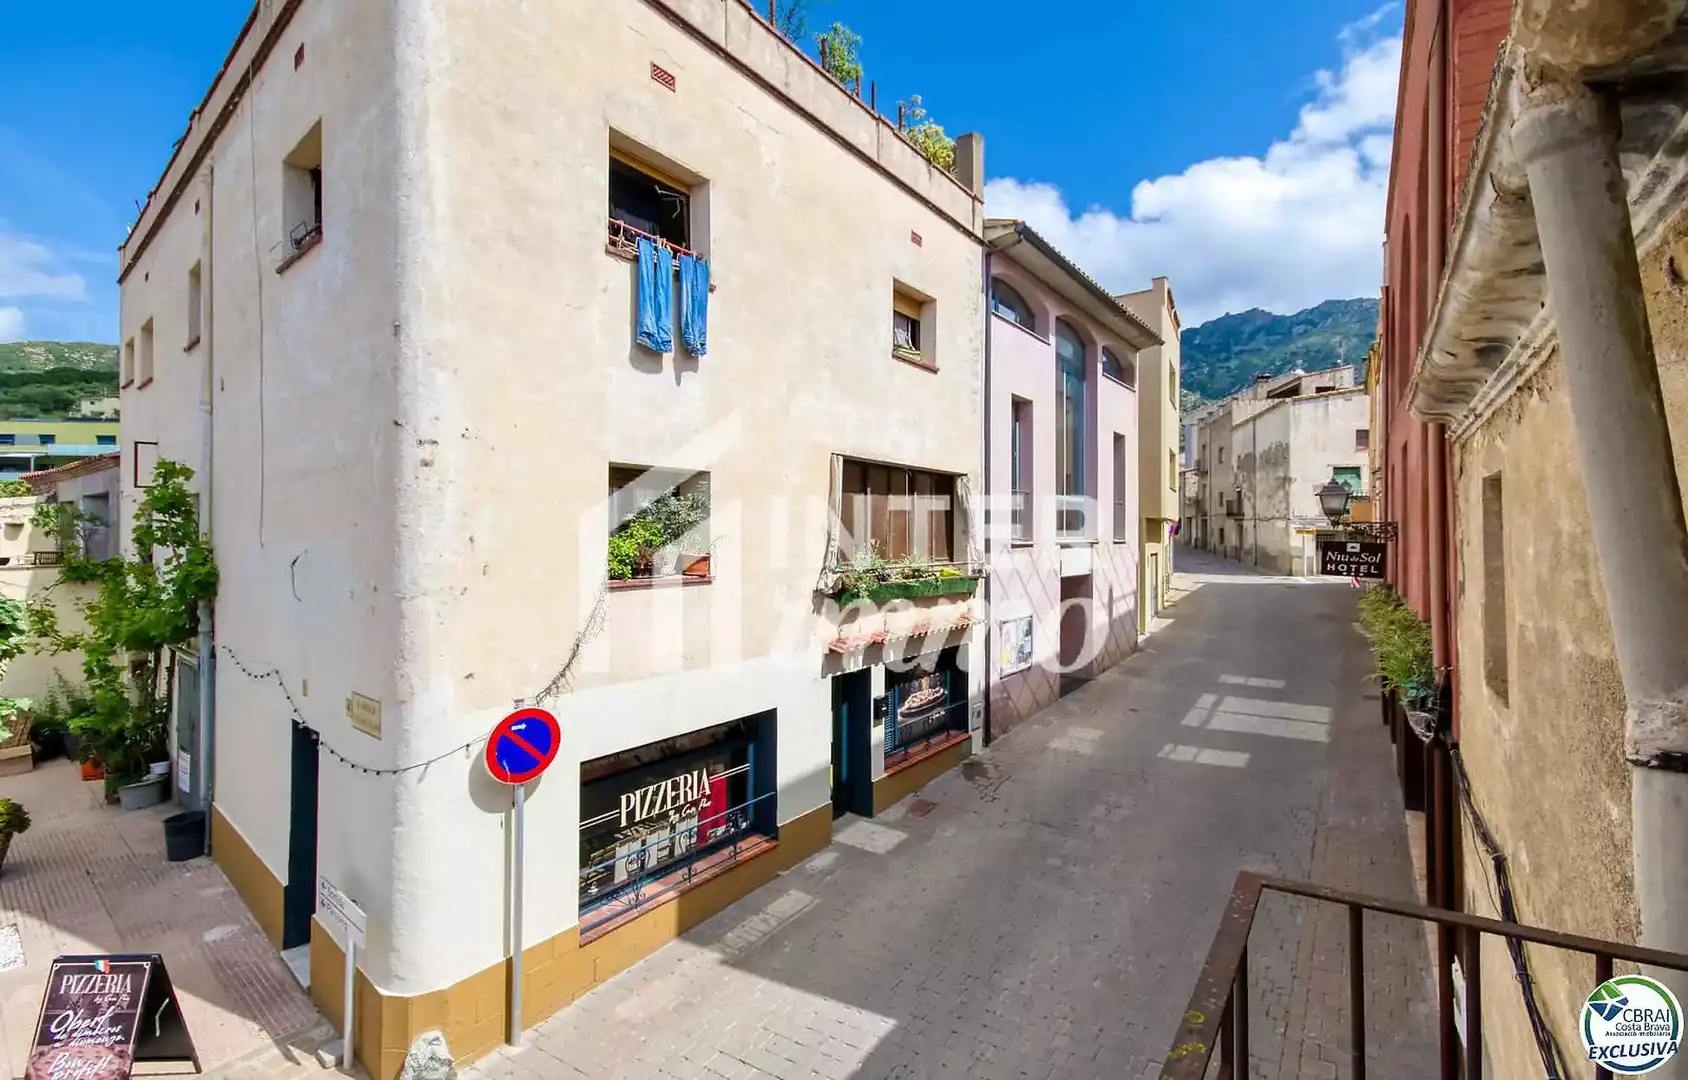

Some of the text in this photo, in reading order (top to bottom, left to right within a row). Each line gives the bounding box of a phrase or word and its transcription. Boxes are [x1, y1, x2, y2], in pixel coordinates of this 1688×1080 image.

[1326, 551, 1350, 562] Niu
[1360, 552, 1381, 563] Sol
[1327, 563, 1379, 574] HOTEL
[619, 767, 712, 828] PIZZERIA
[59, 973, 132, 994] PIZZERIA
[50, 1005, 117, 1034] Obert
